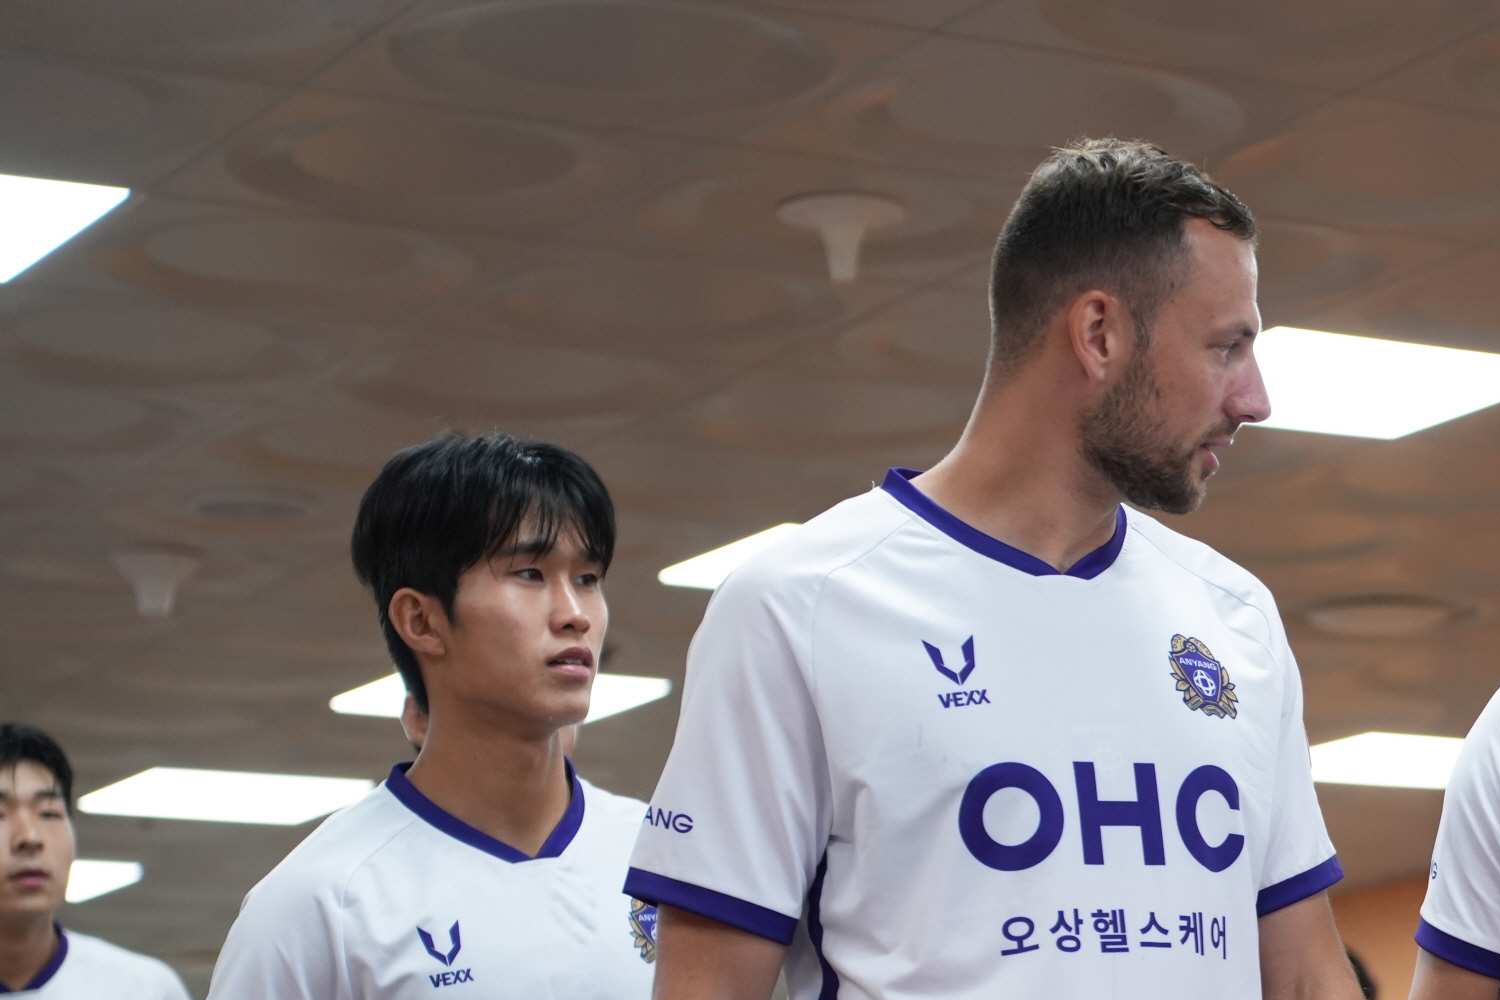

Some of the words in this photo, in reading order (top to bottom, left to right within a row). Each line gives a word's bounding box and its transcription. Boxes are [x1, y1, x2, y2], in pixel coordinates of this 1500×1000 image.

[1179, 657, 1217, 671] ANYANG
[937, 689, 991, 709] VEXX
[957, 762, 1245, 873] OHC
[1000, 908, 1227, 960] 오상헬스케어
[429, 968, 474, 988] VEXX
